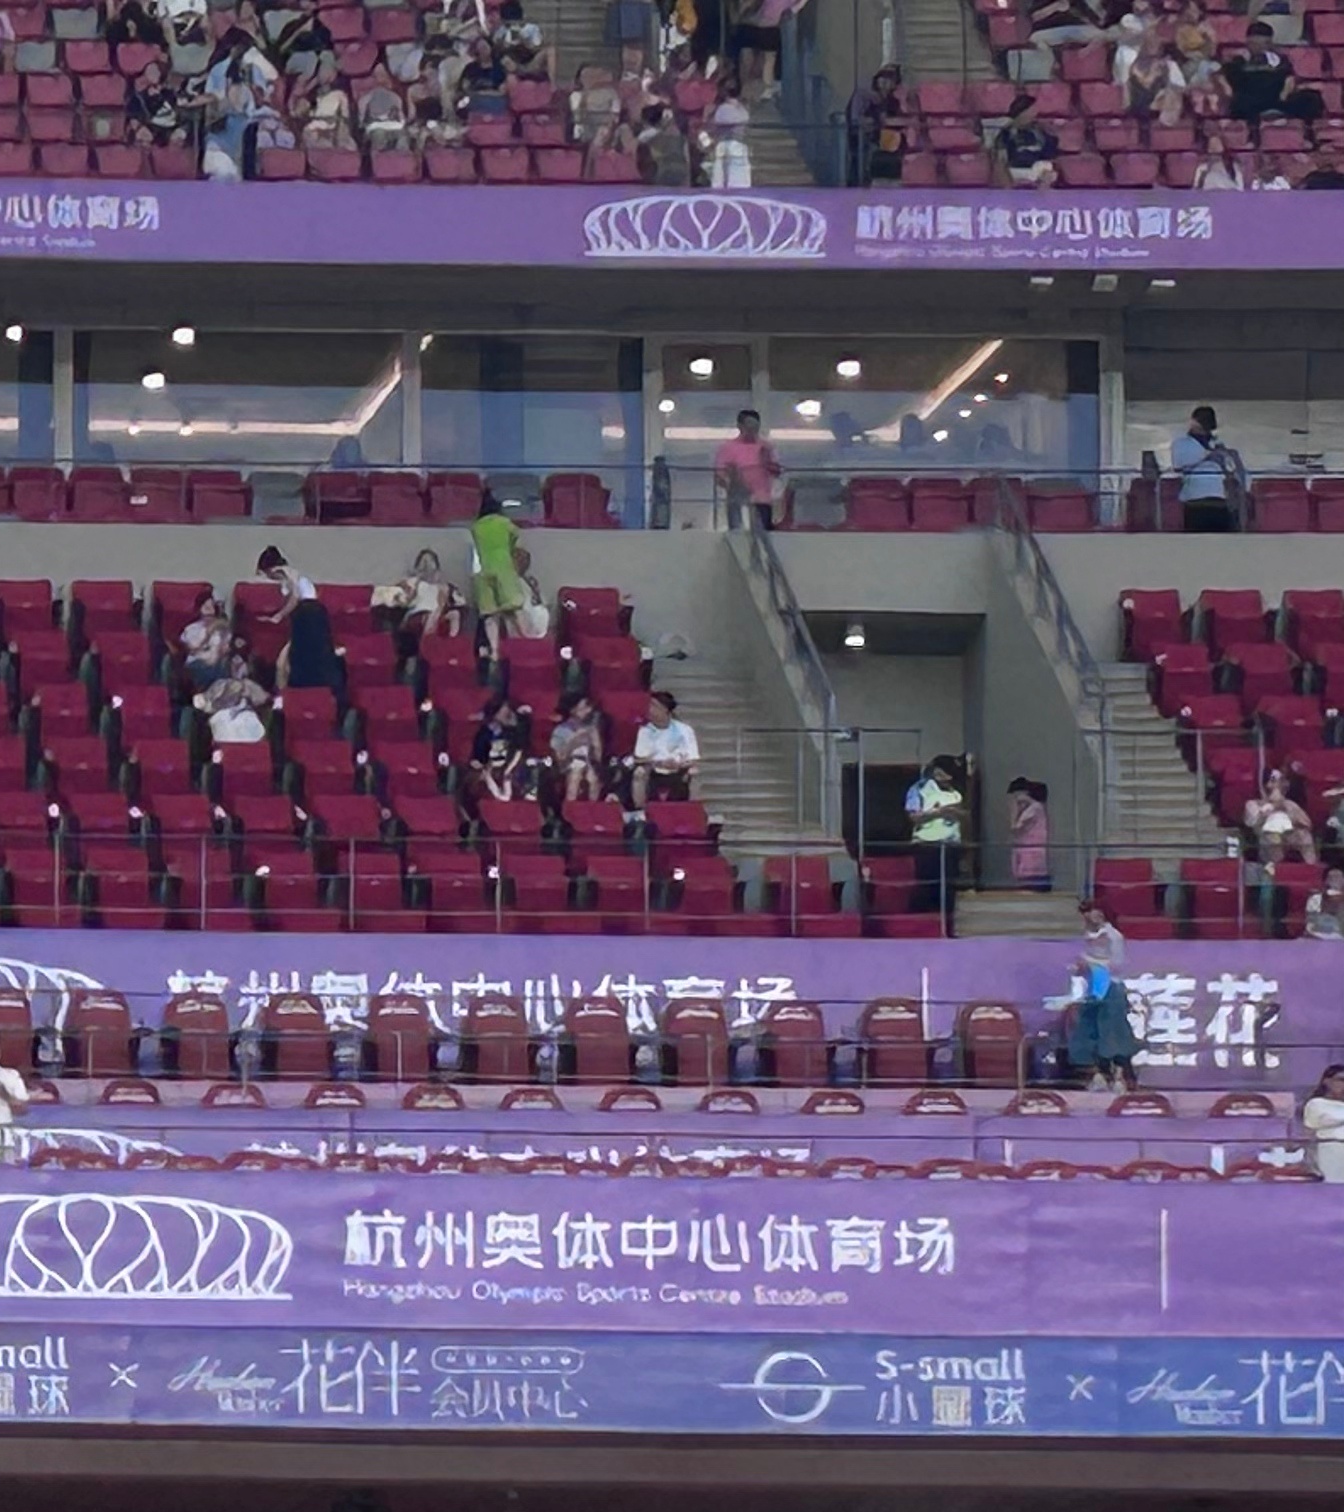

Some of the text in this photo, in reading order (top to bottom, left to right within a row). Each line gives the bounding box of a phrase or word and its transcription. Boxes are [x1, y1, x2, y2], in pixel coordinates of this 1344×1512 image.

[343, 1208, 955, 1275] 杭州奥体中心体育场
[279, 1338, 422, 1415] 花伴
[875, 1348, 1026, 1381] S-small
